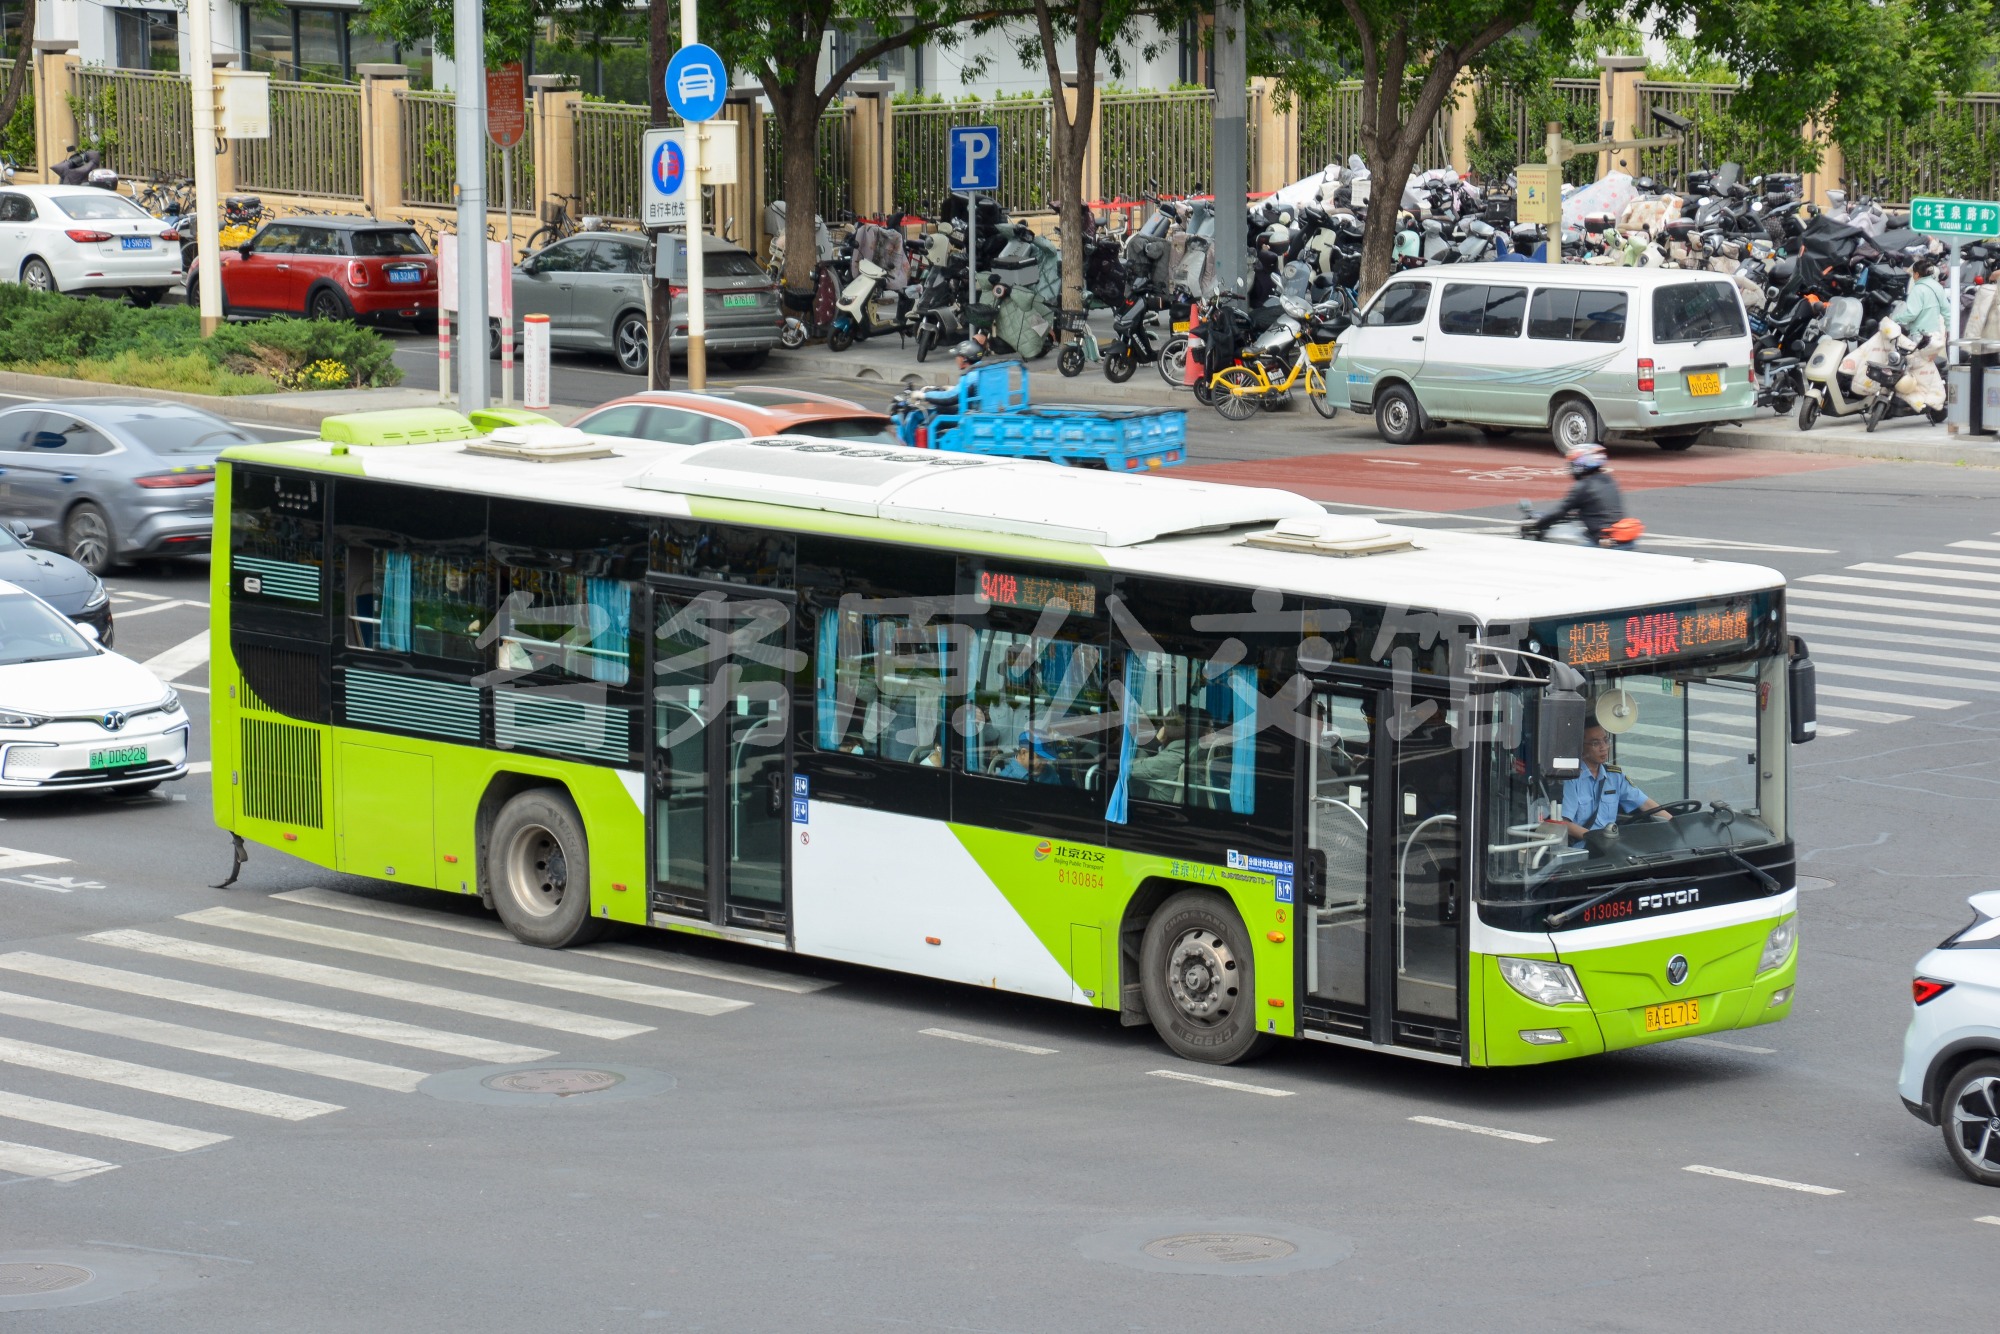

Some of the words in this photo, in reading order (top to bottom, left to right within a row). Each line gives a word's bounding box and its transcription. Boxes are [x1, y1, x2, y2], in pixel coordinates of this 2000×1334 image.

[960, 133, 990, 184] P
[650, 202, 686, 217] 自行车优先
[1940, 221, 1961, 230] YUQUAN
[1965, 223, 1972, 231] LU
[1681, 609, 1748, 645] 莲花池南路
[1568, 643, 1610, 665] 生态园
[1053, 857, 1069, 866] Beijing
[1082, 861, 1104, 871] Transport
[1055, 846, 1106, 863] 北京公交
[1058, 868, 1104, 890] 8130854
[1638, 888, 1699, 911] FOTON
[1584, 900, 1633, 922] 8130854
